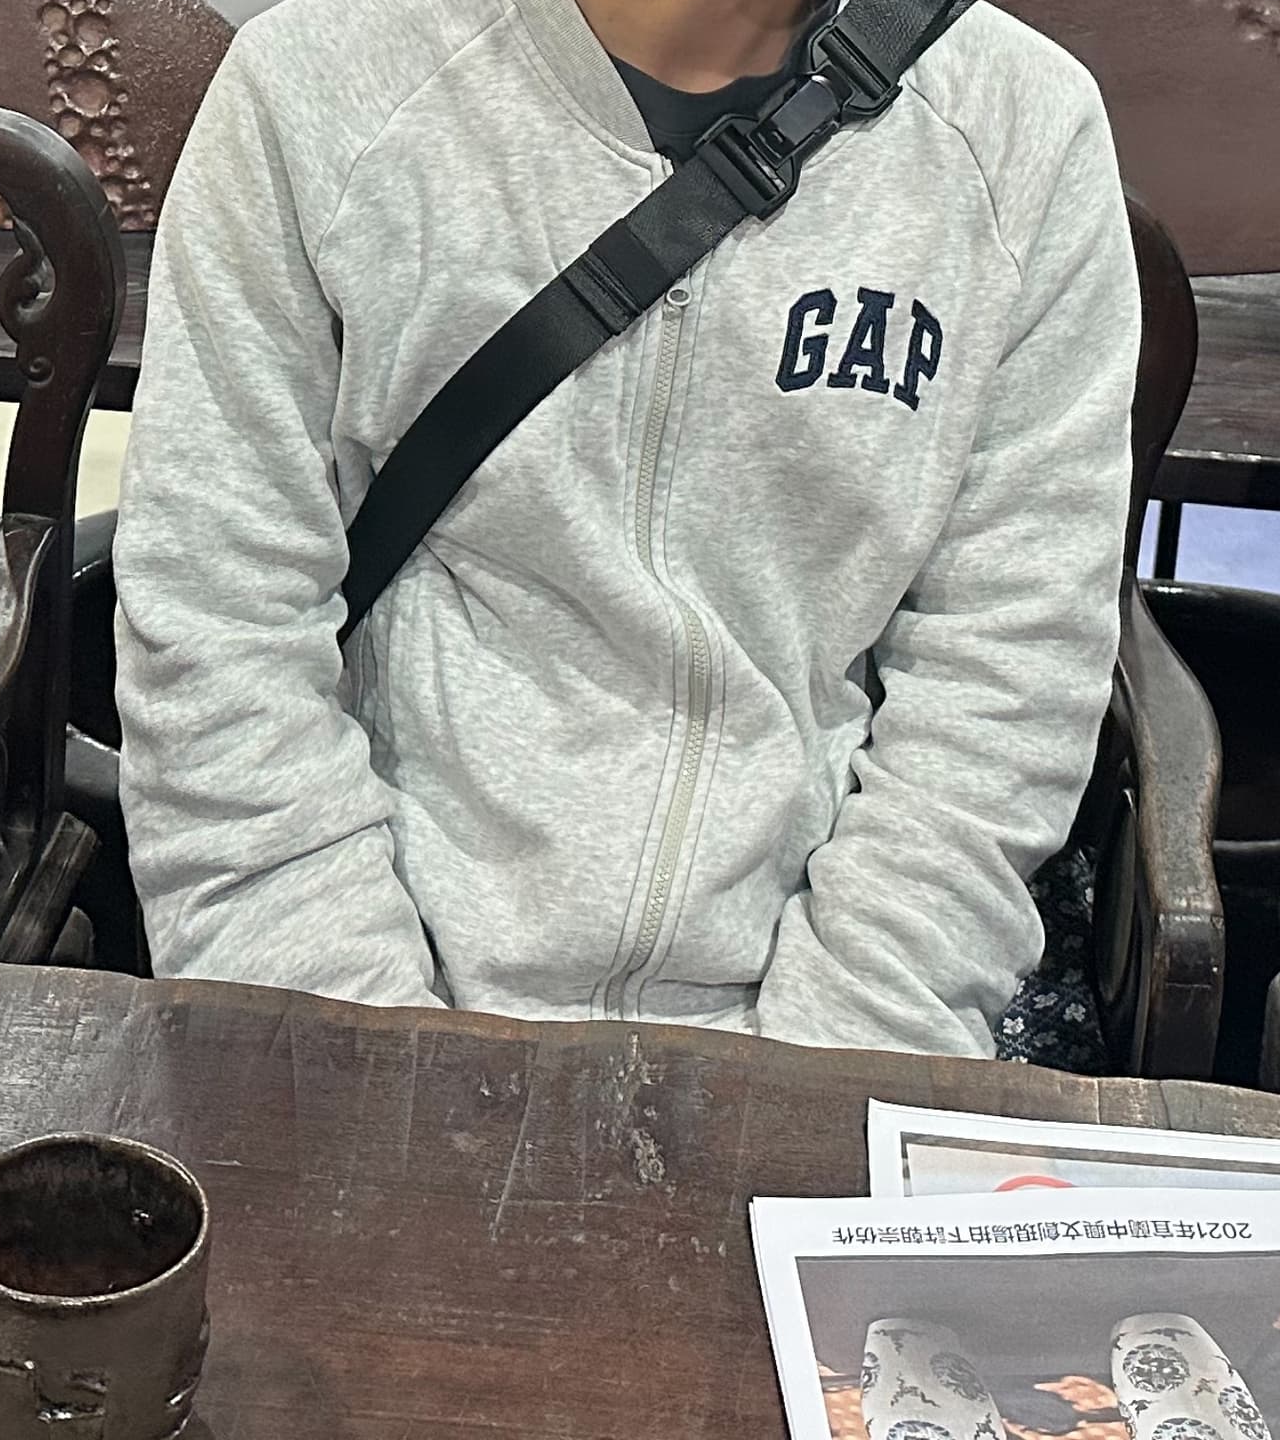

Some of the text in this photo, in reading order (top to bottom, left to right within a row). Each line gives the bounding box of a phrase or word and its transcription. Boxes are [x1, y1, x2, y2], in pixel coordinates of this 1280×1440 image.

[775, 286, 943, 412] GAP
[832, 1219, 1253, 1245] 2021年宜蘭中興文創現場拍下許朝宗仿作
